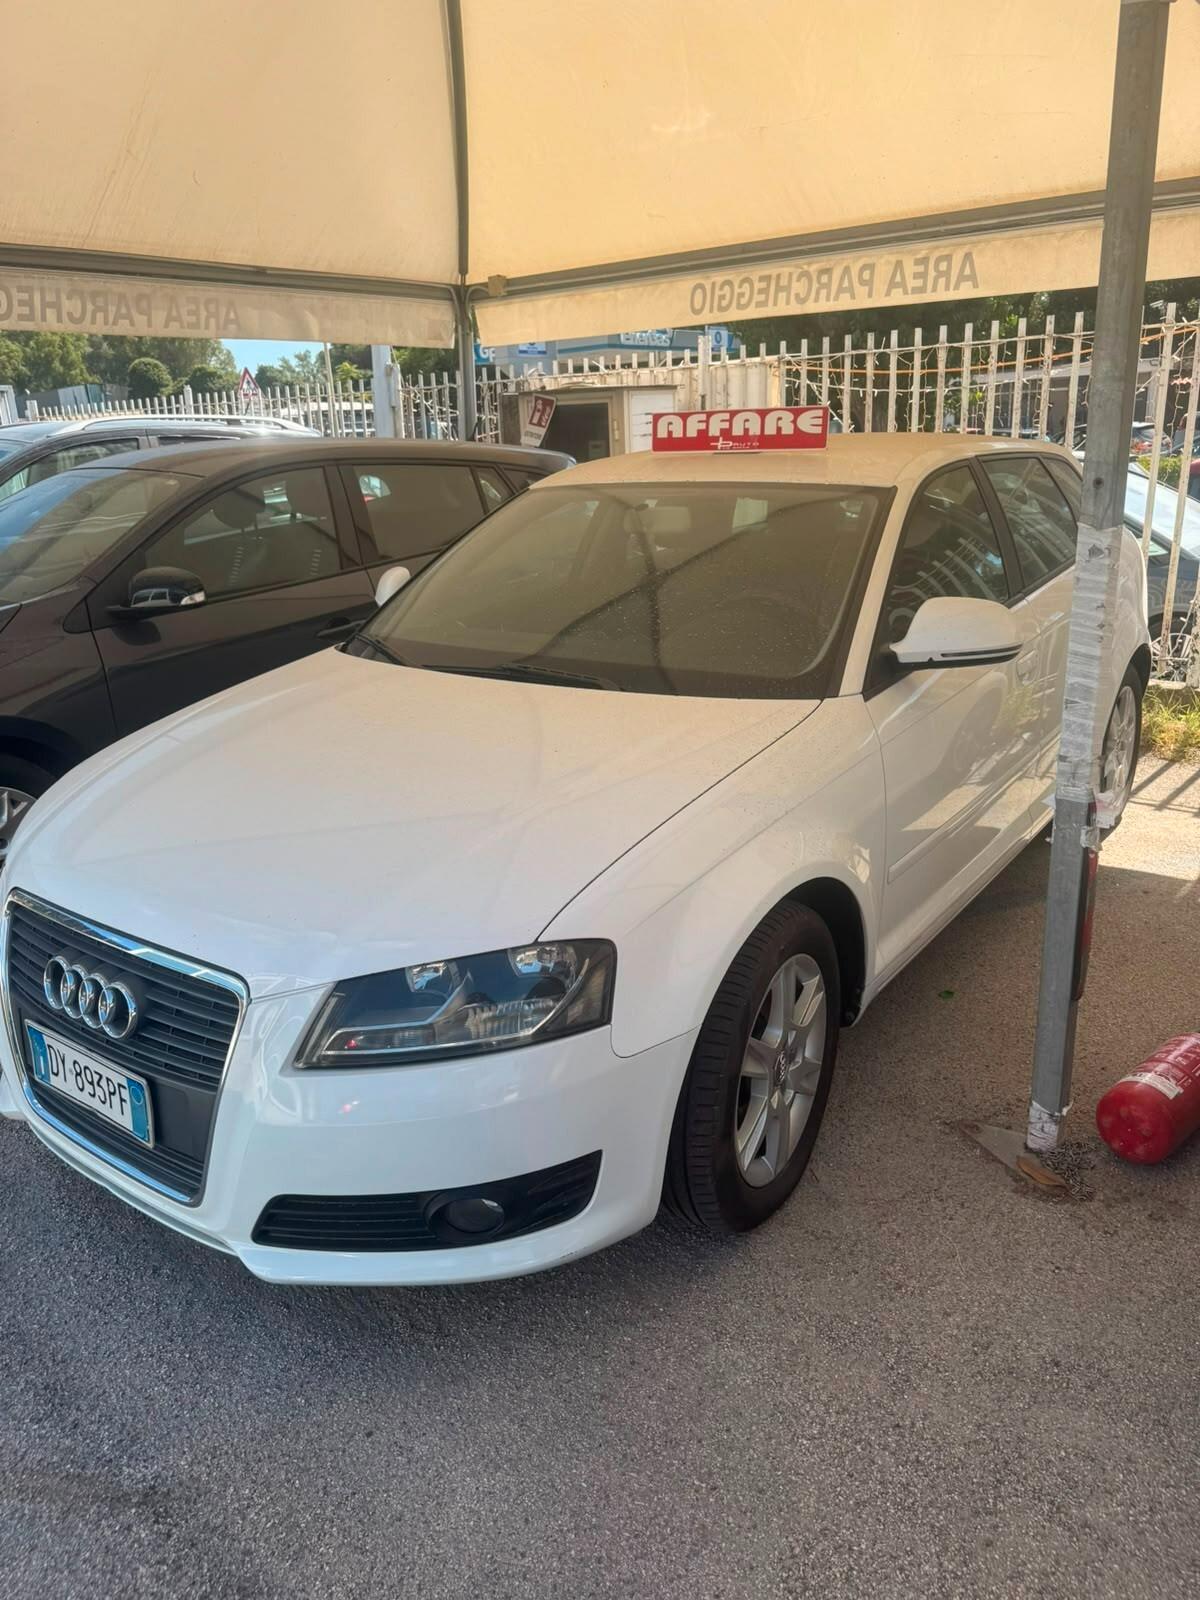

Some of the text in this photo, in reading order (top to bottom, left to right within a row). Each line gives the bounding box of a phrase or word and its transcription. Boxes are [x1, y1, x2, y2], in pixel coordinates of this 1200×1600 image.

[656, 409, 824, 439] AFFARE
[46, 1043, 129, 1117] DY 893PF
